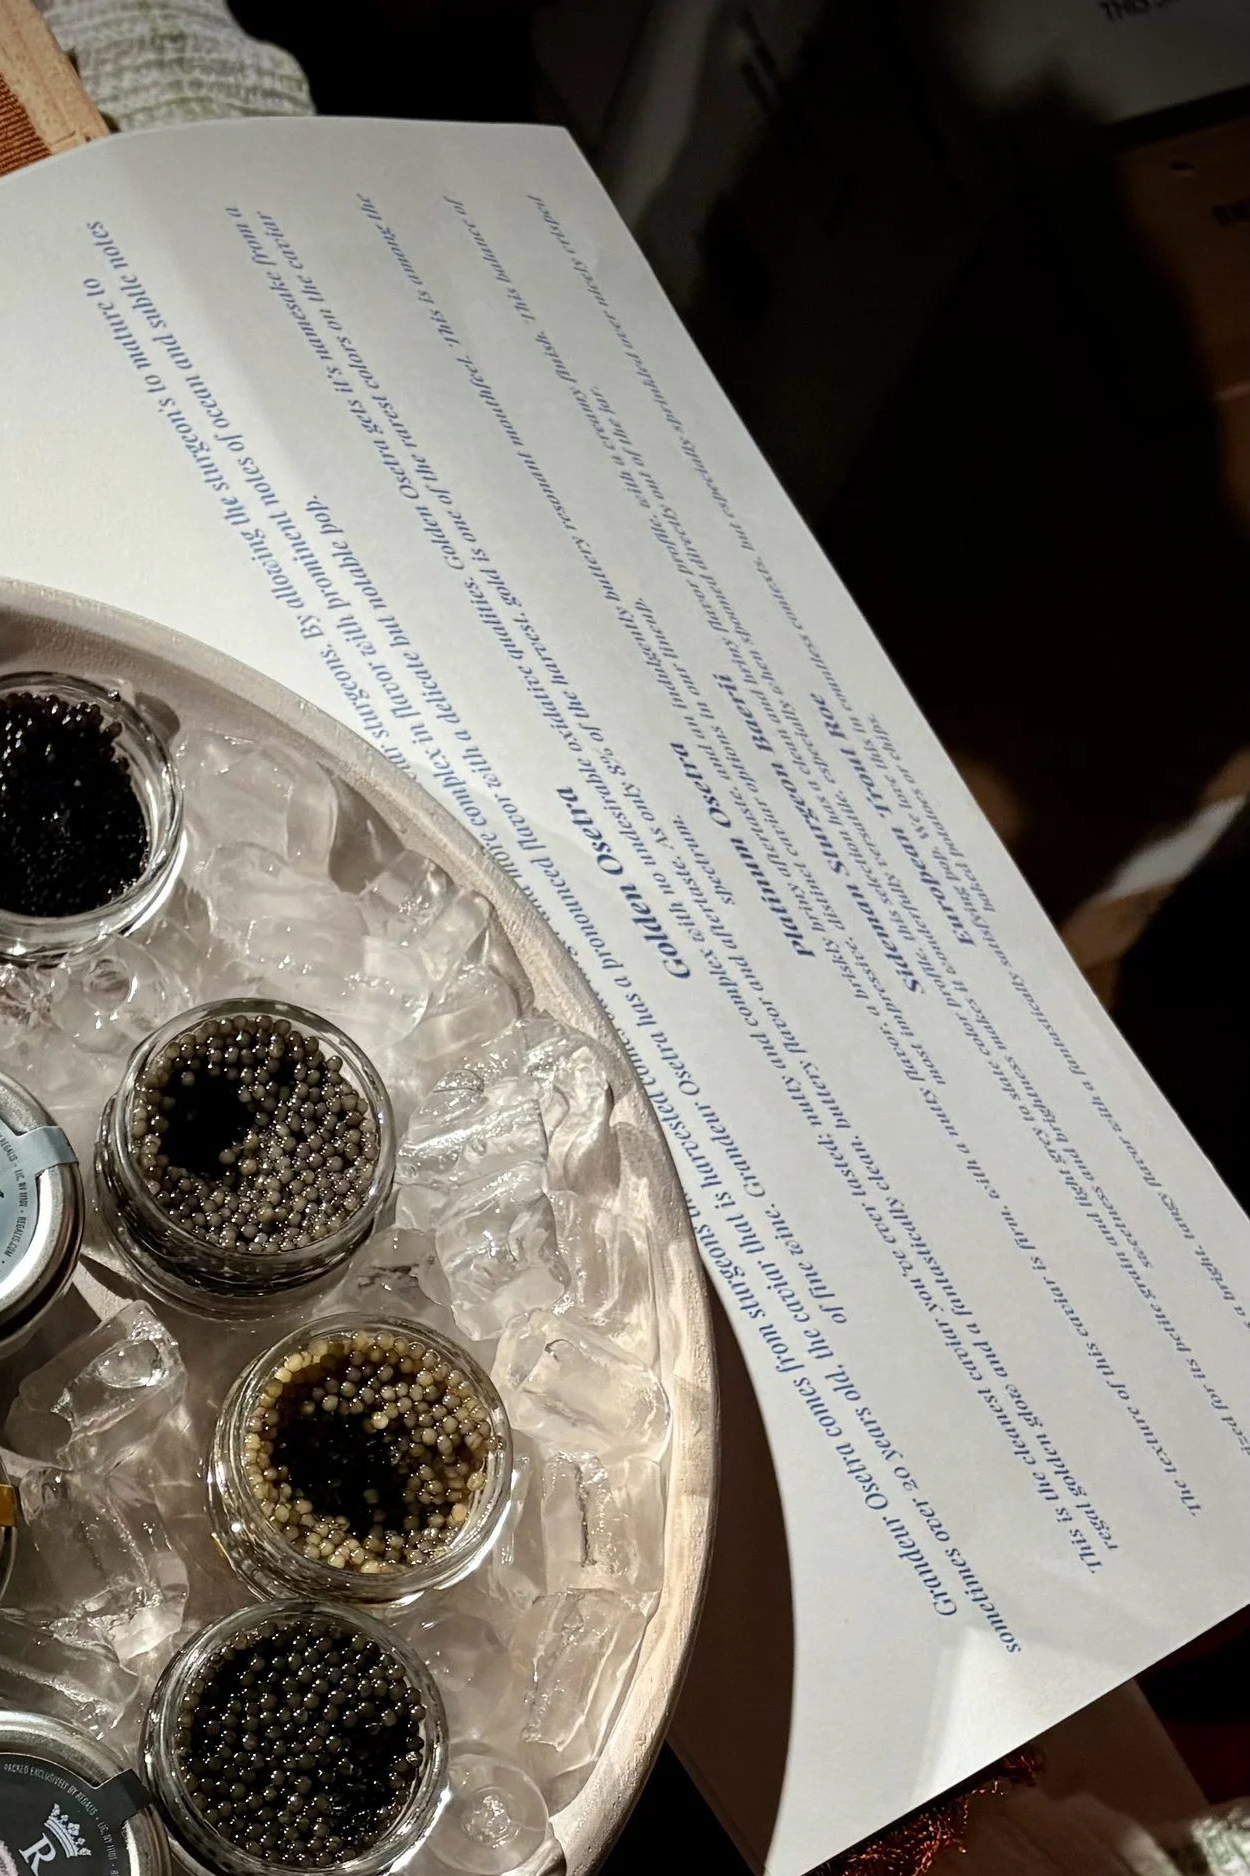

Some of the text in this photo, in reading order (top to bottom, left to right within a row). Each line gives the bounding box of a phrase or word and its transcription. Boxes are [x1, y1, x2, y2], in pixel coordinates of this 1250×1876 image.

[86, 221, 129, 270] notes
[119, 275, 167, 329] subtle
[151, 333, 193, 370] and
[185, 374, 230, 429] ocean
[213, 434, 245, 452] of
[82, 278, 390, 739] sturgeons. By allowing the sturgeon's to mature to
[237, 456, 280, 507] notes
[268, 510, 352, 610] prominent
[336, 614, 377, 657] with
[367, 662, 422, 719] flavor
[409, 722, 434, 745] in
[425, 748, 488, 827] complex
[555, 786, 624, 876] Osetra
[712, 673, 926, 994] Sideman Sturgeon Baerii
[809, 692, 976, 946] European Trout Roe
[669, 742, 816, 958] Platinum Osetra
[305, 495, 848, 1324] of fine wine. Grandeur Osetra has a pronounced flavor with a delicate but notable pop.
[619, 883, 691, 980] Golden
[649, 1089, 724, 1189] harvested
[714, 1191, 737, 1210] is
[725, 1213, 766, 1255] that
[757, 1260, 811, 1323] caviar
[803, 1328, 835, 1360] the
[696, 1224, 958, 1617] Grandeur Osetra comes from sturgeons
[855, 1406, 904, 1462] years
[893, 1466, 919, 1492] 20
[911, 1497, 951, 1543] over
[944, 1547, 1022, 1653] sometimes
